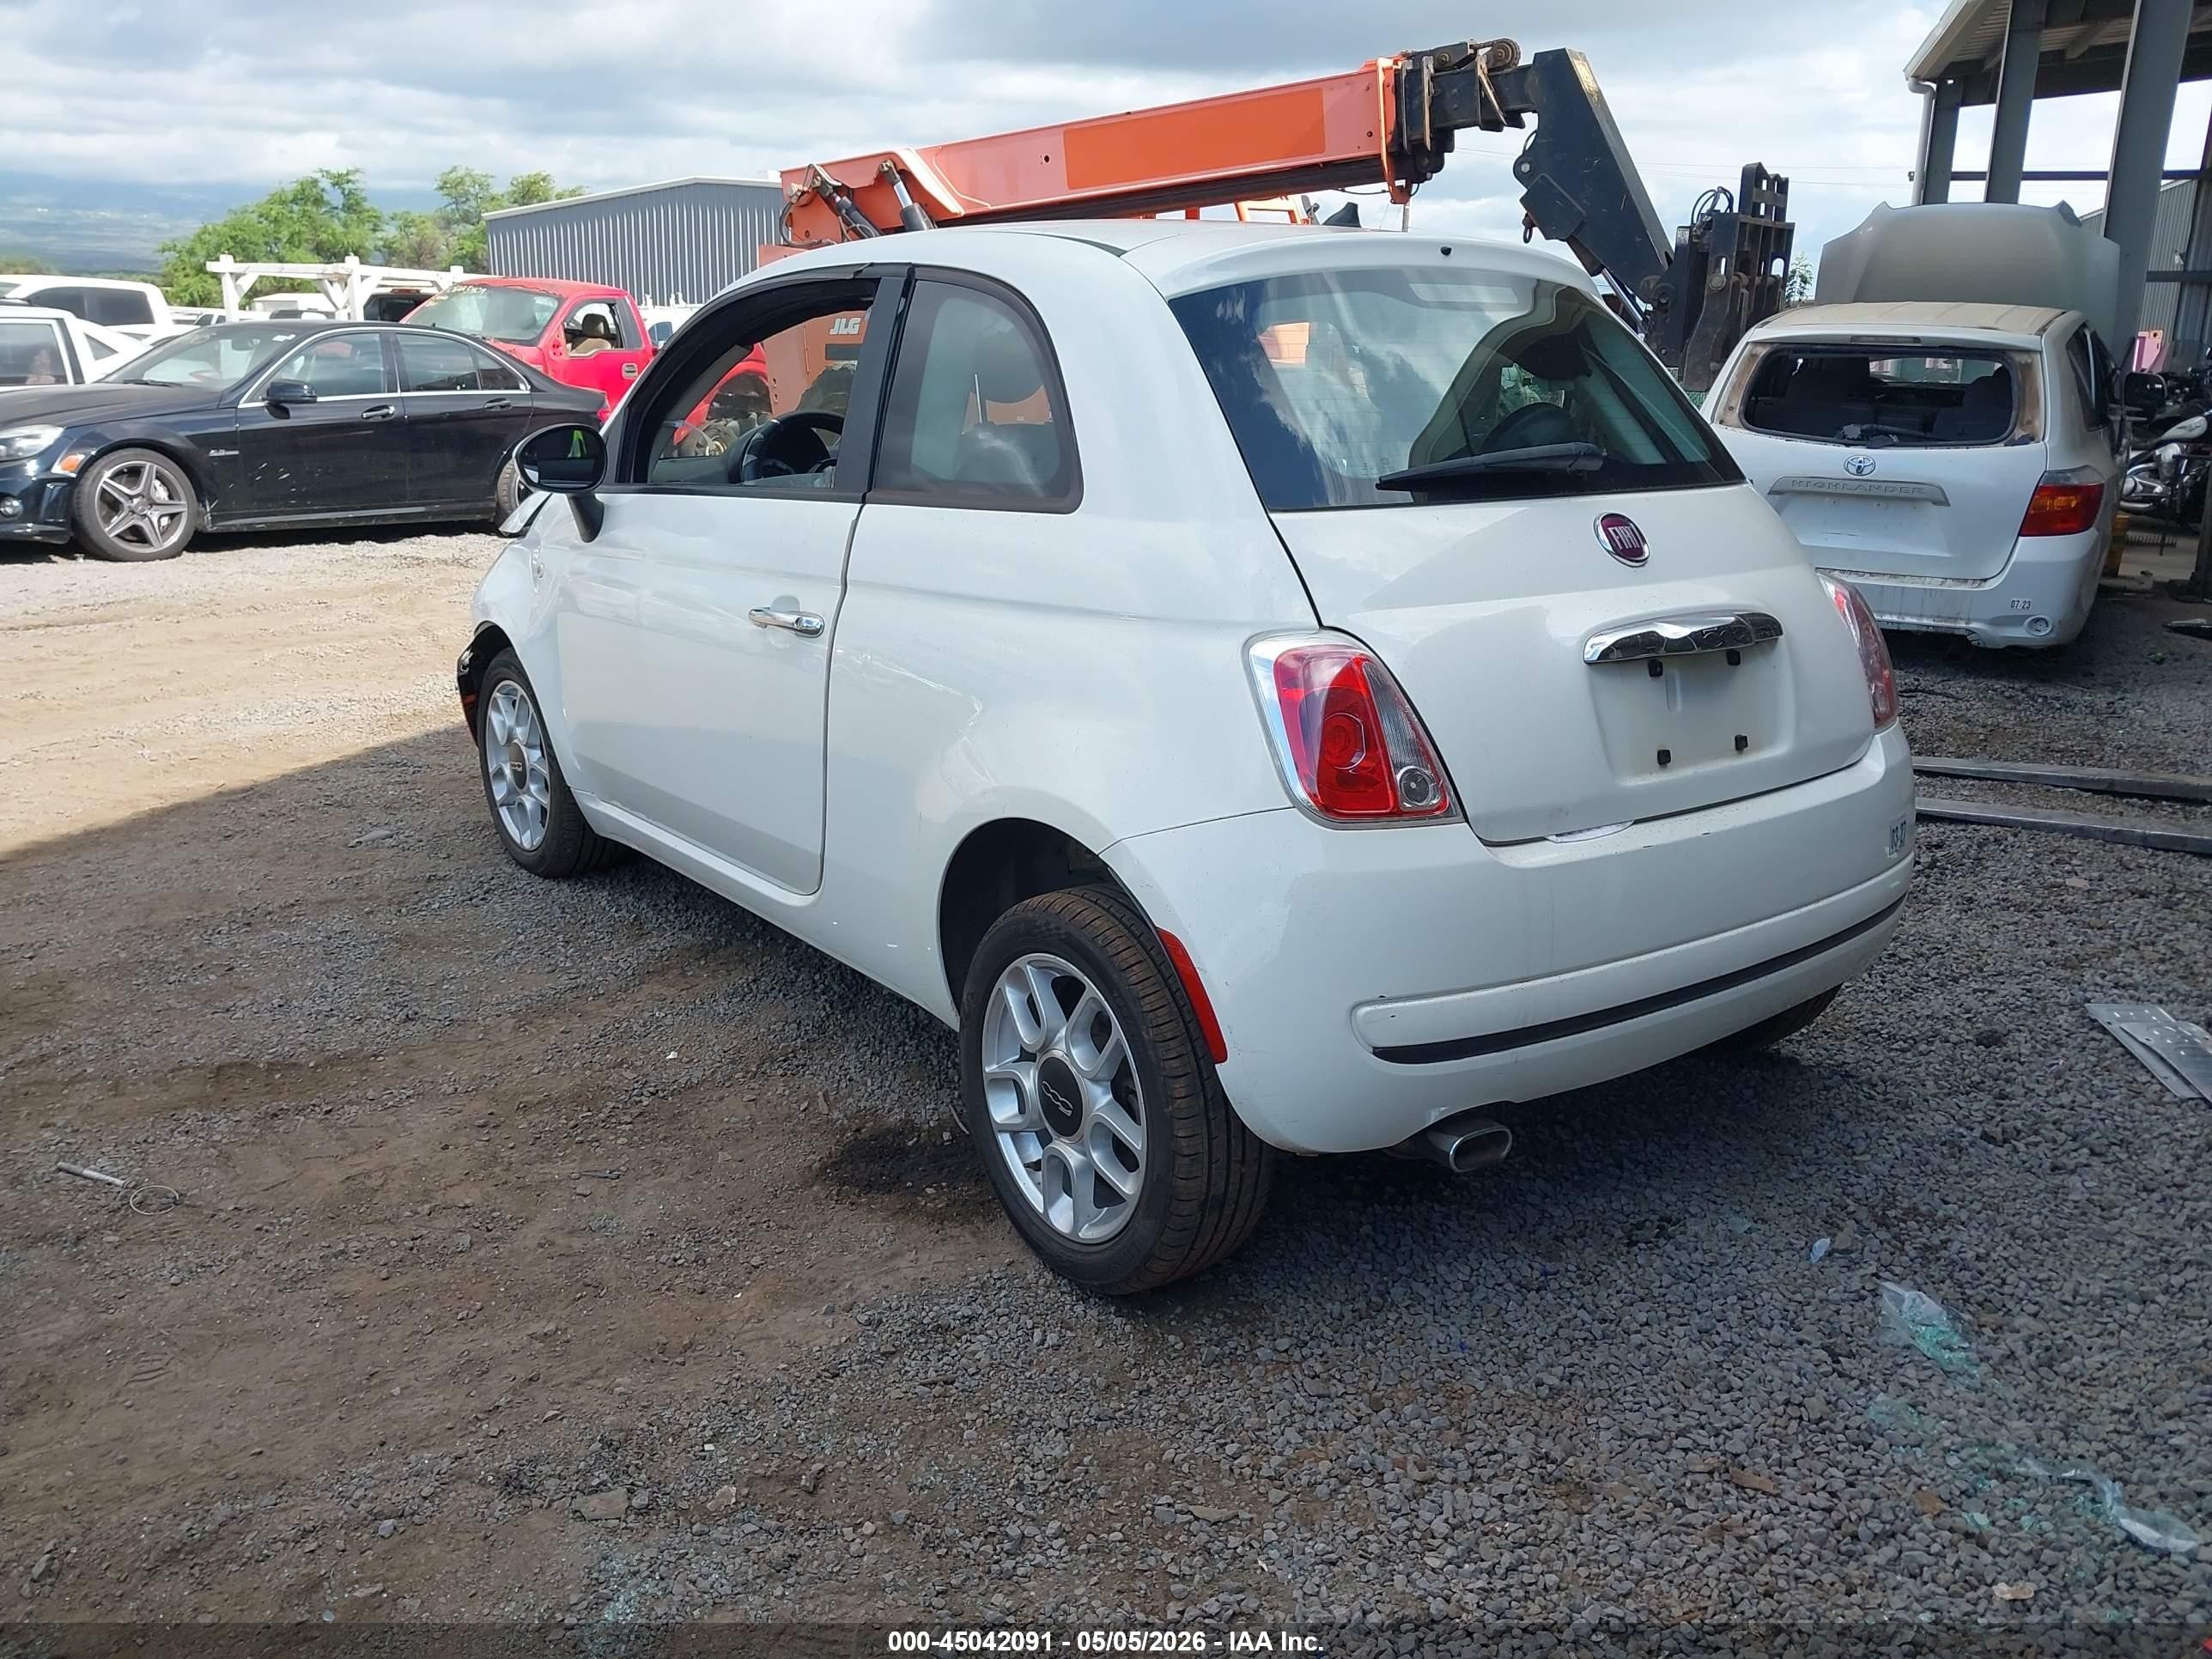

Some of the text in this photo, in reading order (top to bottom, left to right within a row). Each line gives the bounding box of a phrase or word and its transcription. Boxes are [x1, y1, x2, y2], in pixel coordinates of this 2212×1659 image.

[830, 318, 861, 335] JLG
[1791, 479, 1925, 495] HIGHLANDER
[1607, 524, 1644, 550] FIAT
